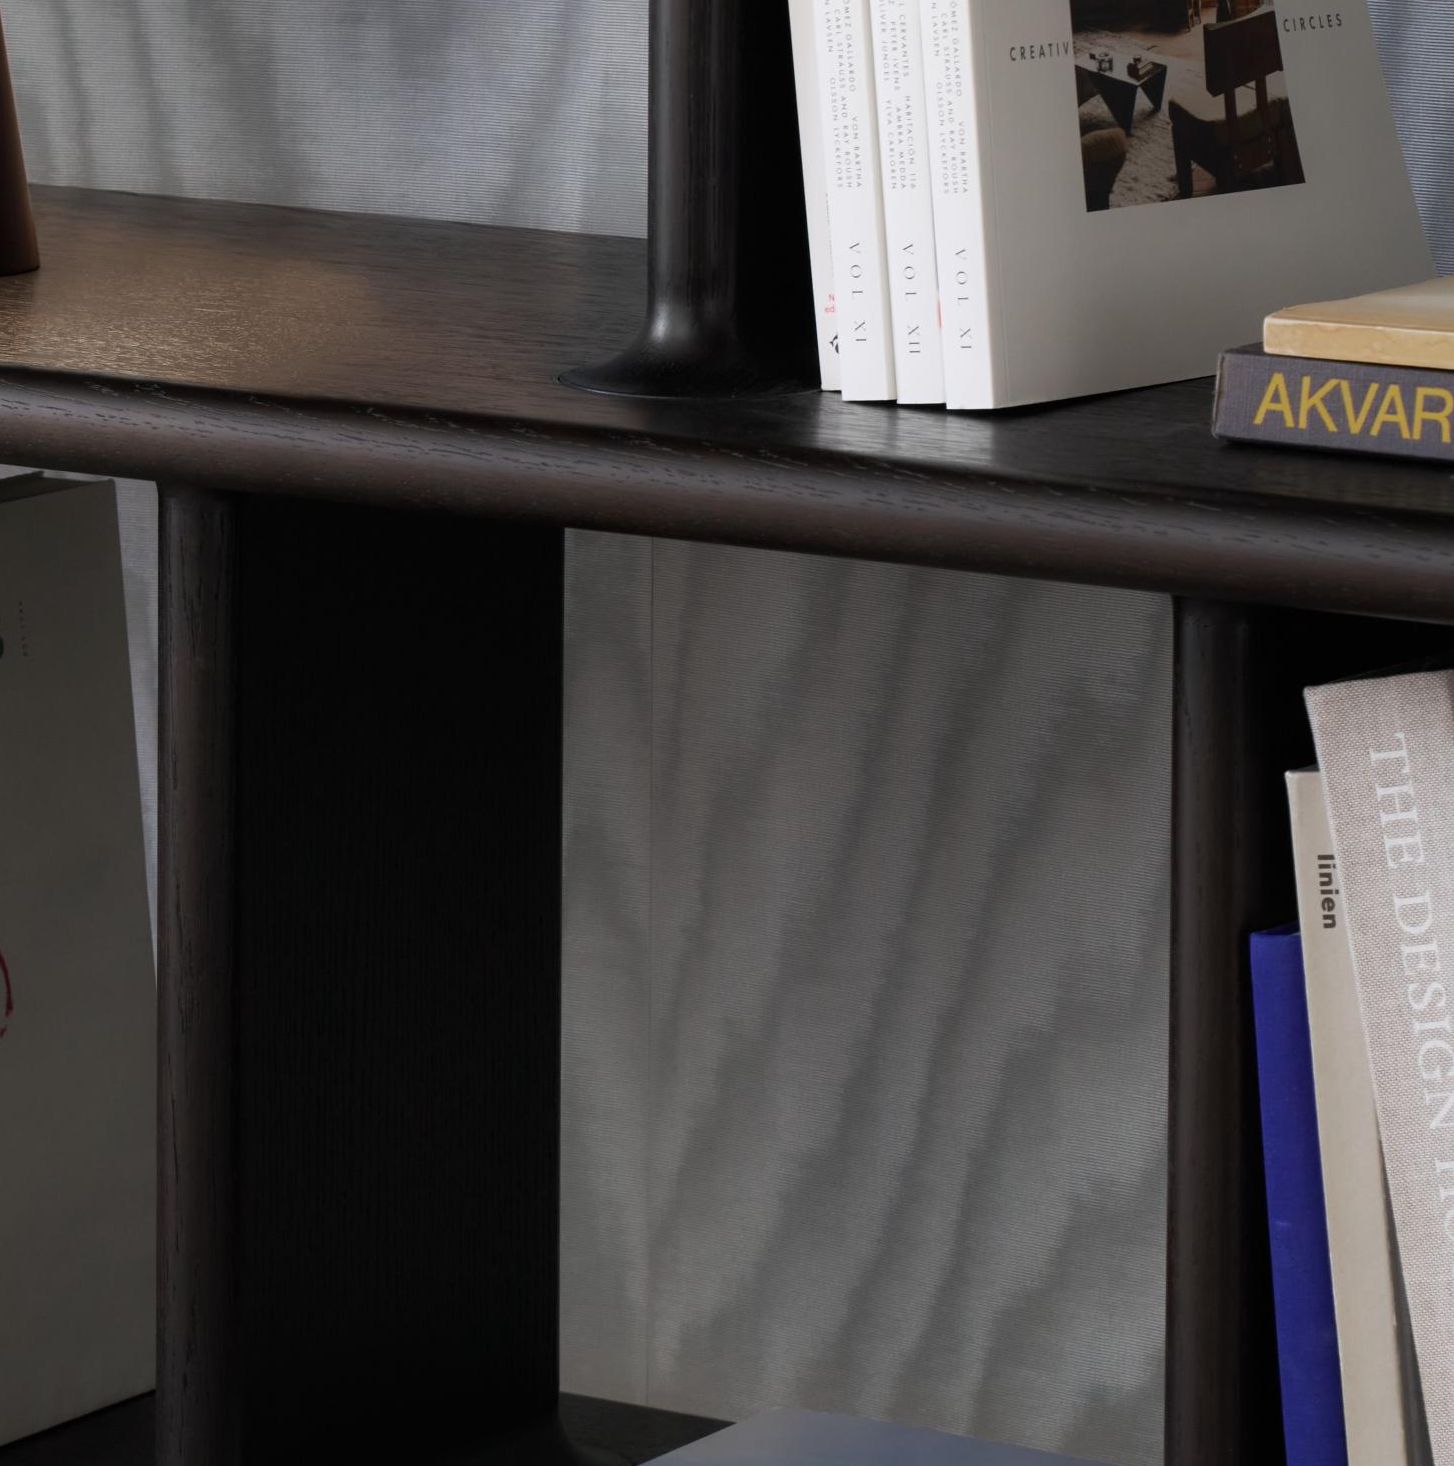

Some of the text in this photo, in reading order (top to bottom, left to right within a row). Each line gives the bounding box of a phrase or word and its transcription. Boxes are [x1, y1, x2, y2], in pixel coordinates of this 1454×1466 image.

[939, 12, 949, 40] CARL
[945, 100, 955, 123] AND
[1283, 12, 1344, 33] CIRCLES
[956, 120, 966, 145] VON
[849, 242, 867, 342] VOL XI
[902, 243, 921, 354] VOL XII
[954, 248, 972, 349] VOL XI
[1253, 371, 1454, 444] AKVAR
[1368, 733, 1425, 870] THE
[1316, 852, 1340, 931] linien
